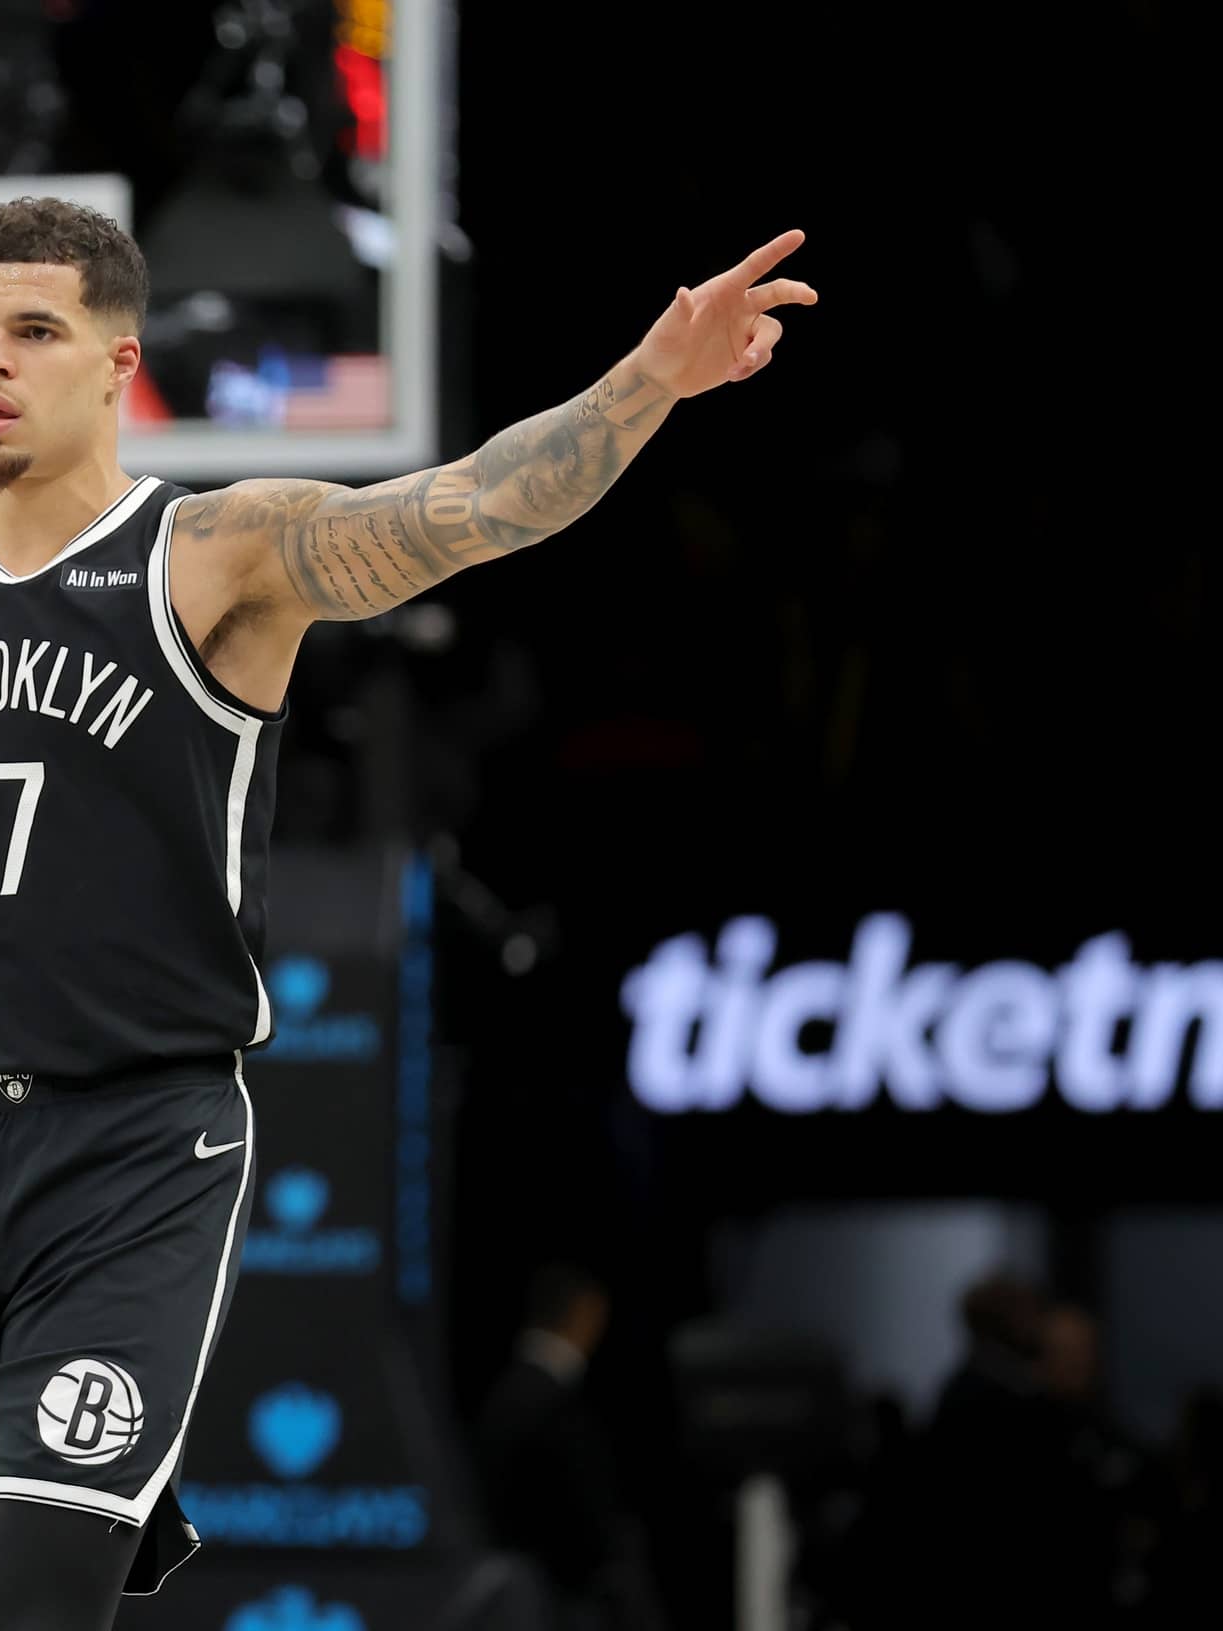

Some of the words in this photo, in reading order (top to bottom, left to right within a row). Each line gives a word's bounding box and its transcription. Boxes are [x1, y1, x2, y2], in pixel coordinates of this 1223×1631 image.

[66, 568, 88, 587] All
[90, 571, 104, 587] In
[107, 570, 137, 587] Won
[64, 1371, 113, 1450] B
